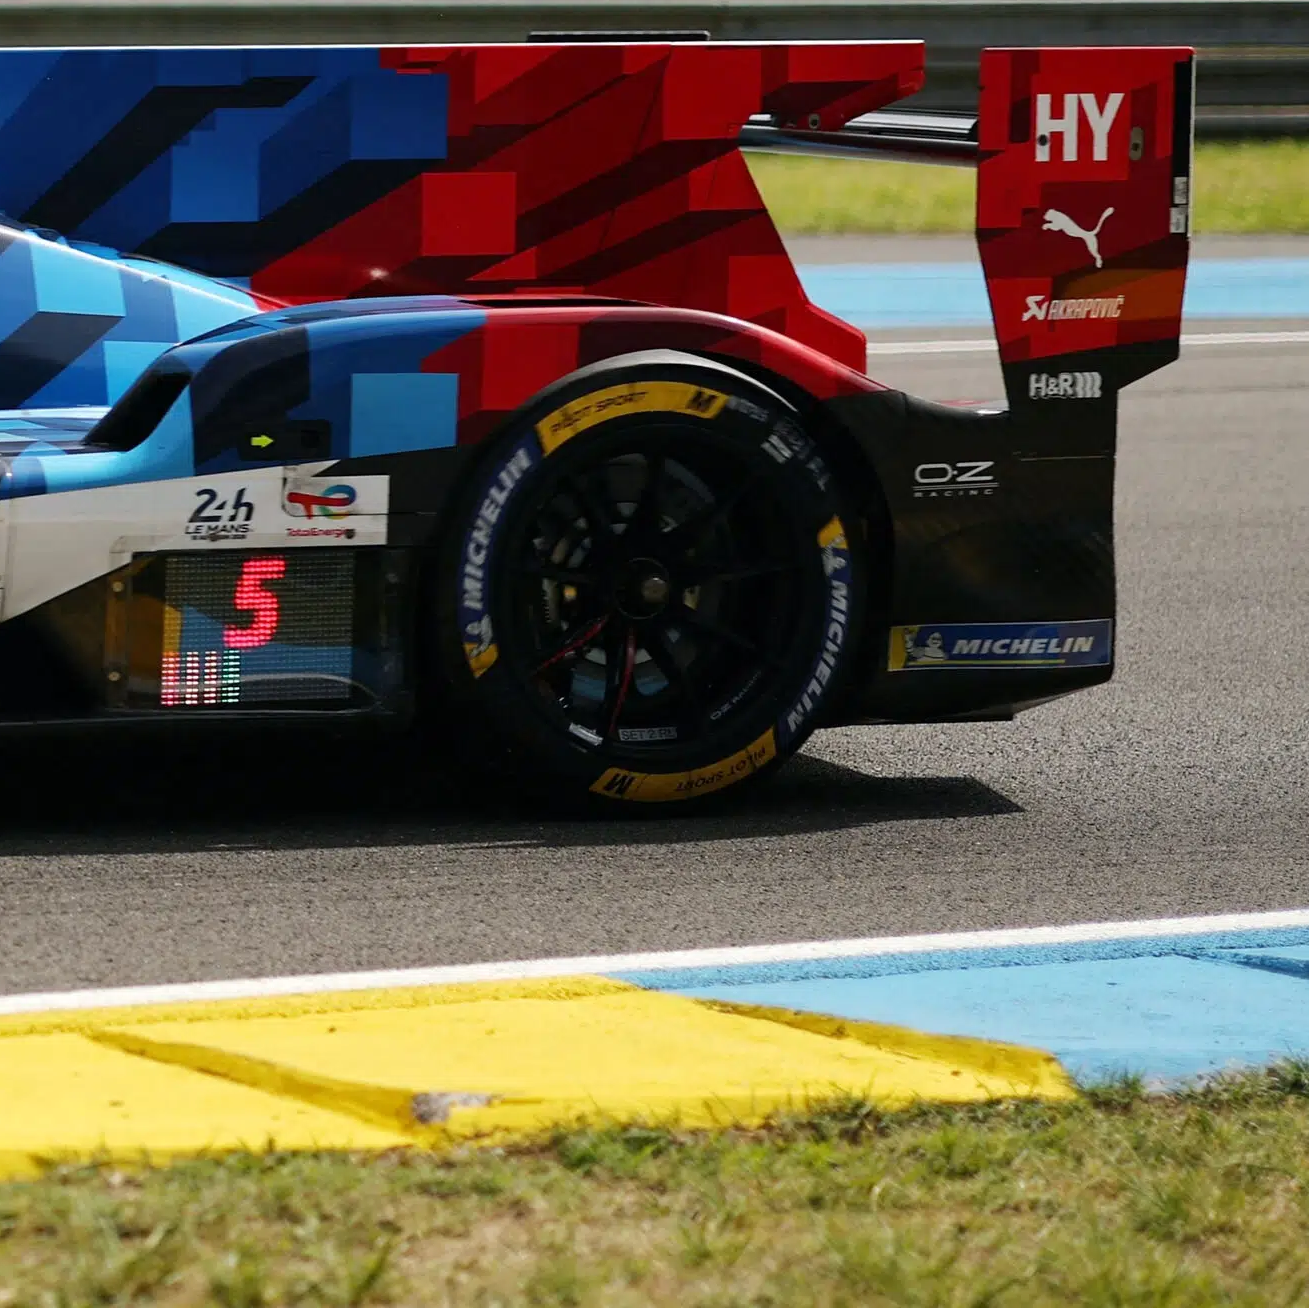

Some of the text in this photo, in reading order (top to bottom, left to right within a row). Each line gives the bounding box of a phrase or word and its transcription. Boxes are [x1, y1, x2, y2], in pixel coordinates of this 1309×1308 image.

[1035, 93, 1125, 162] HY
[206, 524, 250, 534] MANS
[286, 527, 356, 539] TotalEnergi
[462, 447, 533, 611] MICHELIN
[223, 558, 286, 649] 5
[786, 579, 848, 733] MICHELIN
[952, 636, 1095, 655] MICHELIN
